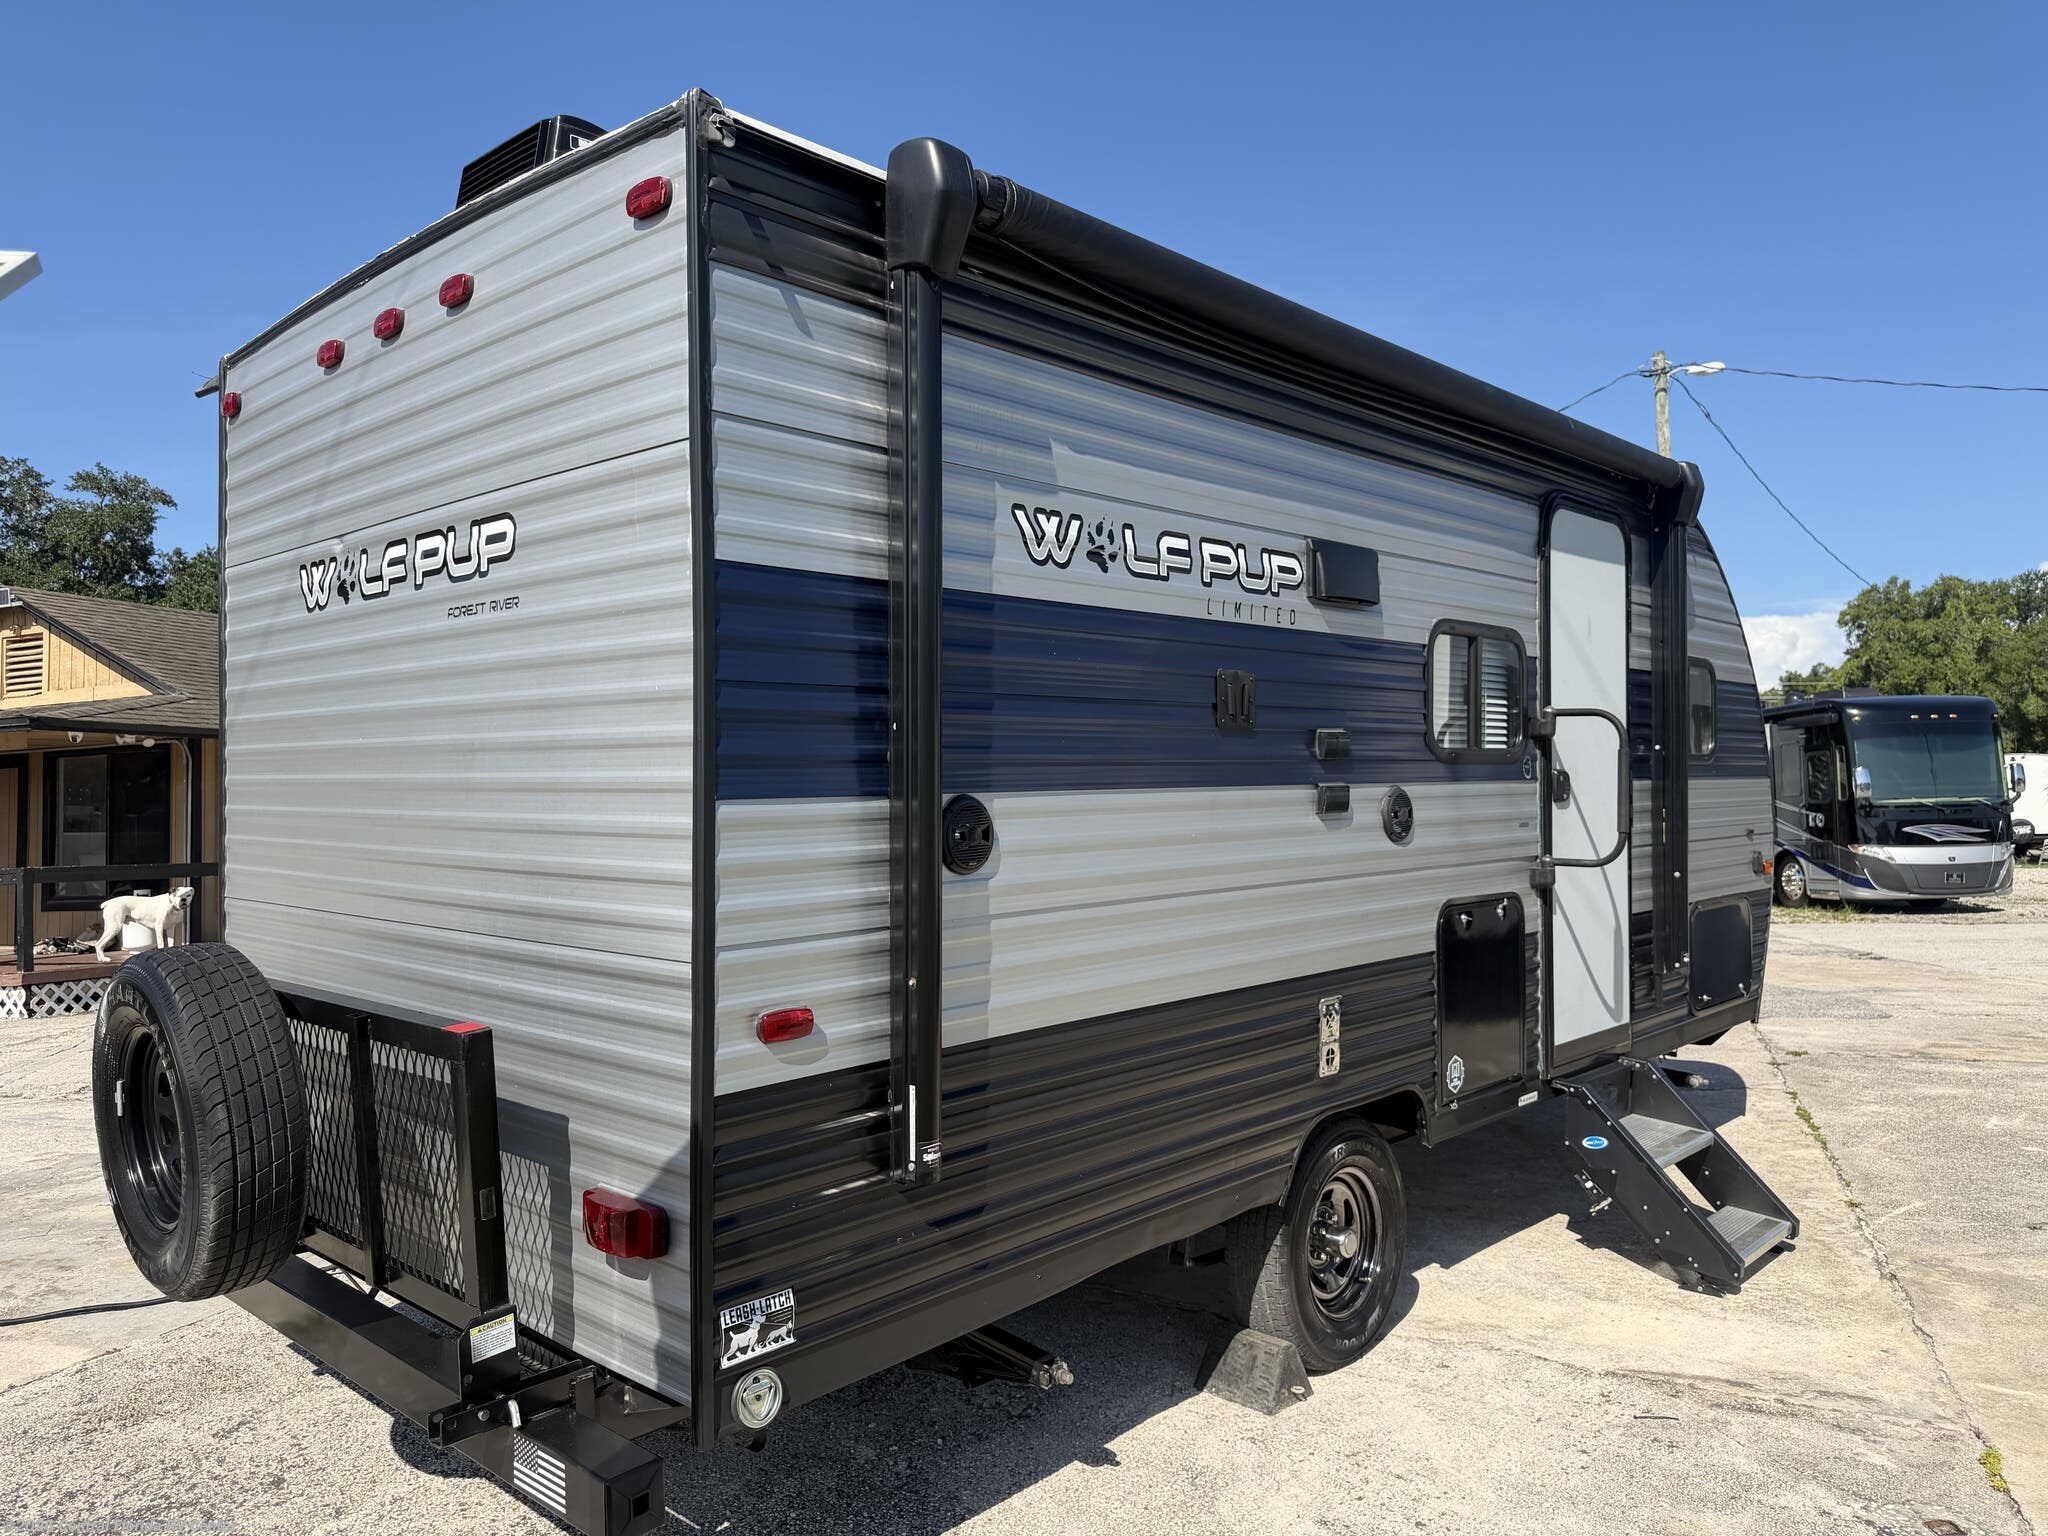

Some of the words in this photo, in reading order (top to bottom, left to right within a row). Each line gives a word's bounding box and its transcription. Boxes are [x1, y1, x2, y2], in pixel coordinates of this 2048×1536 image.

[414, 512, 517, 591] PUP
[1199, 537, 1304, 597] PUP
[447, 602, 486, 619] FOREST
[489, 596, 520, 613] RIVER
[1207, 598, 1296, 625] LIMITED
[481, 1318, 507, 1331] CAUTION
